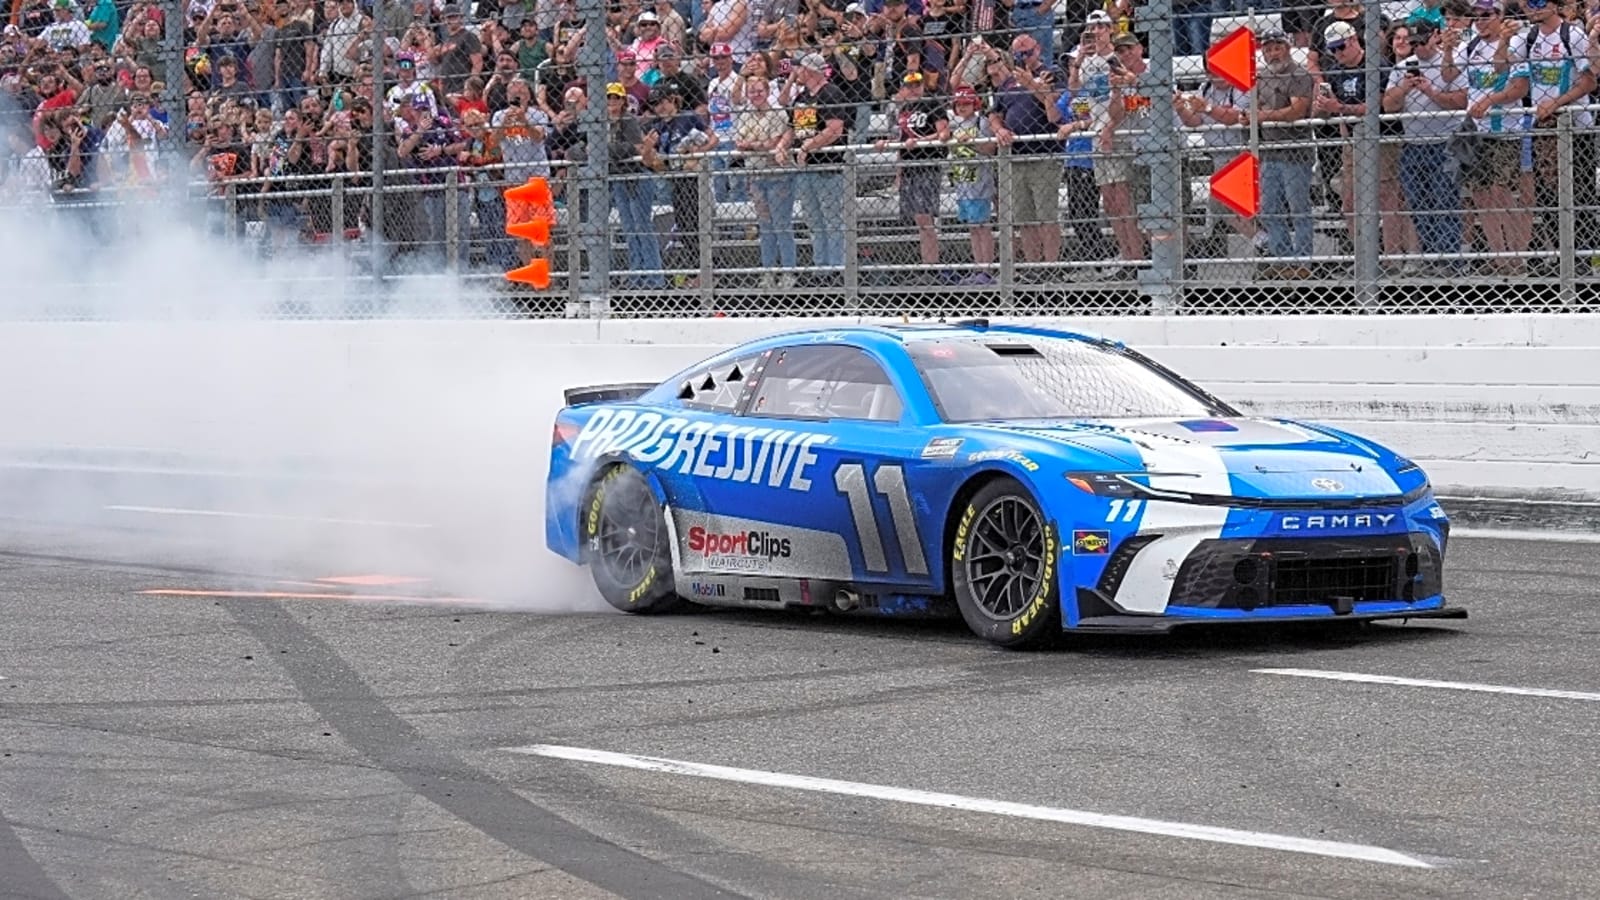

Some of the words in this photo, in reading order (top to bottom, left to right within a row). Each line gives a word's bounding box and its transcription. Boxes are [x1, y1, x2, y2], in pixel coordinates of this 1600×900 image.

[569, 408, 832, 492] PROGRESSIVE
[834, 463, 929, 576] 11
[954, 503, 976, 561] EAGLE
[1105, 499, 1142, 522] 11
[688, 526, 791, 562] SportClips
